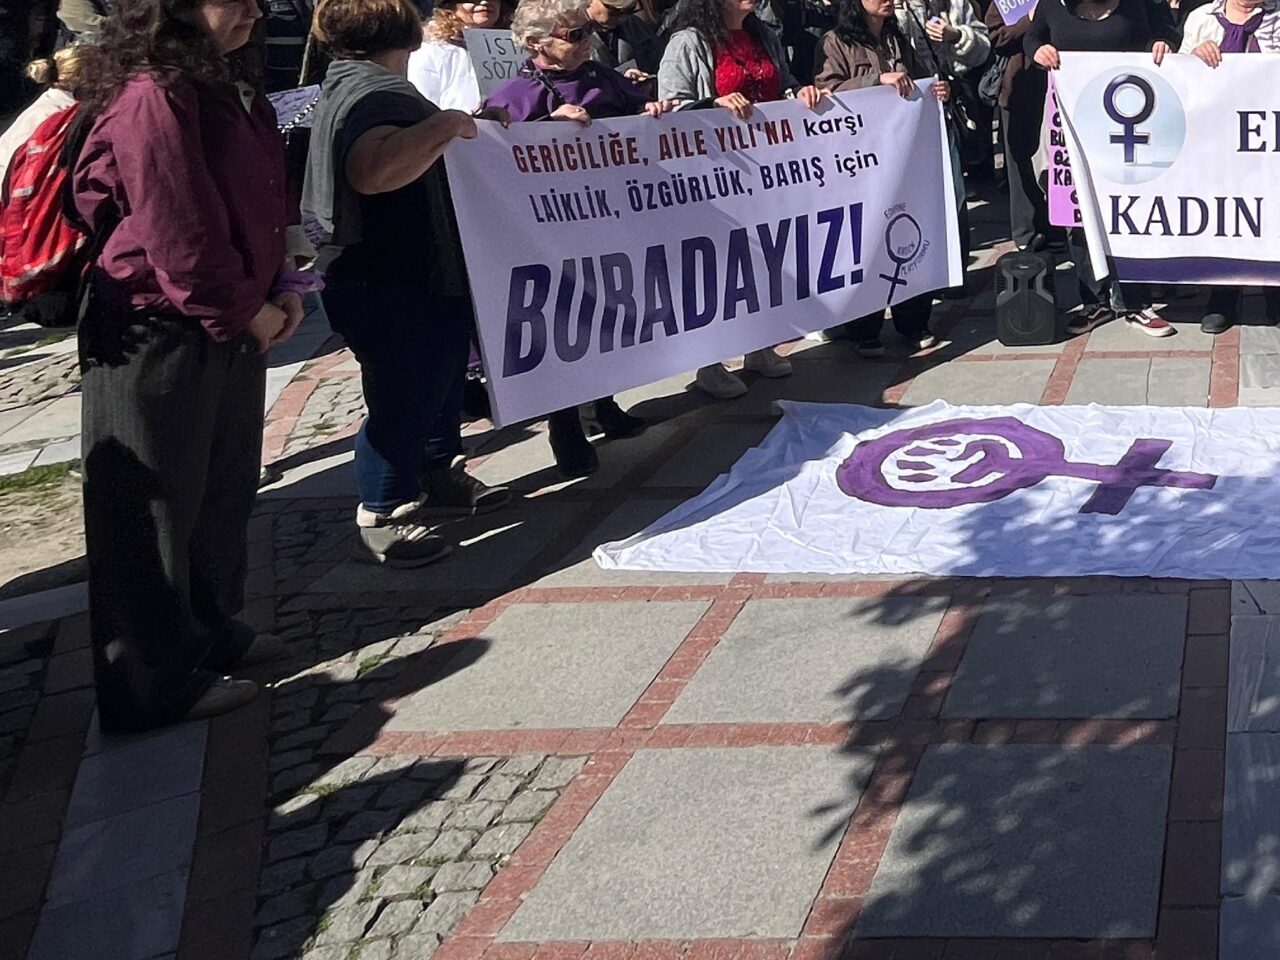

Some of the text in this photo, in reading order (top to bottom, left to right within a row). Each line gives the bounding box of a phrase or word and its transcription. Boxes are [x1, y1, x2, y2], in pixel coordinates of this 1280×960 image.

[511, 112, 864, 174] GERİCİLİĞE, AİLE YILI'NA karşı
[528, 148, 880, 224] LAİKLİK, ÖZGÜRLÜK, BARIŞ için
[1108, 195, 1264, 238] KADIN
[502, 201, 864, 379] BURADAYIZ!
